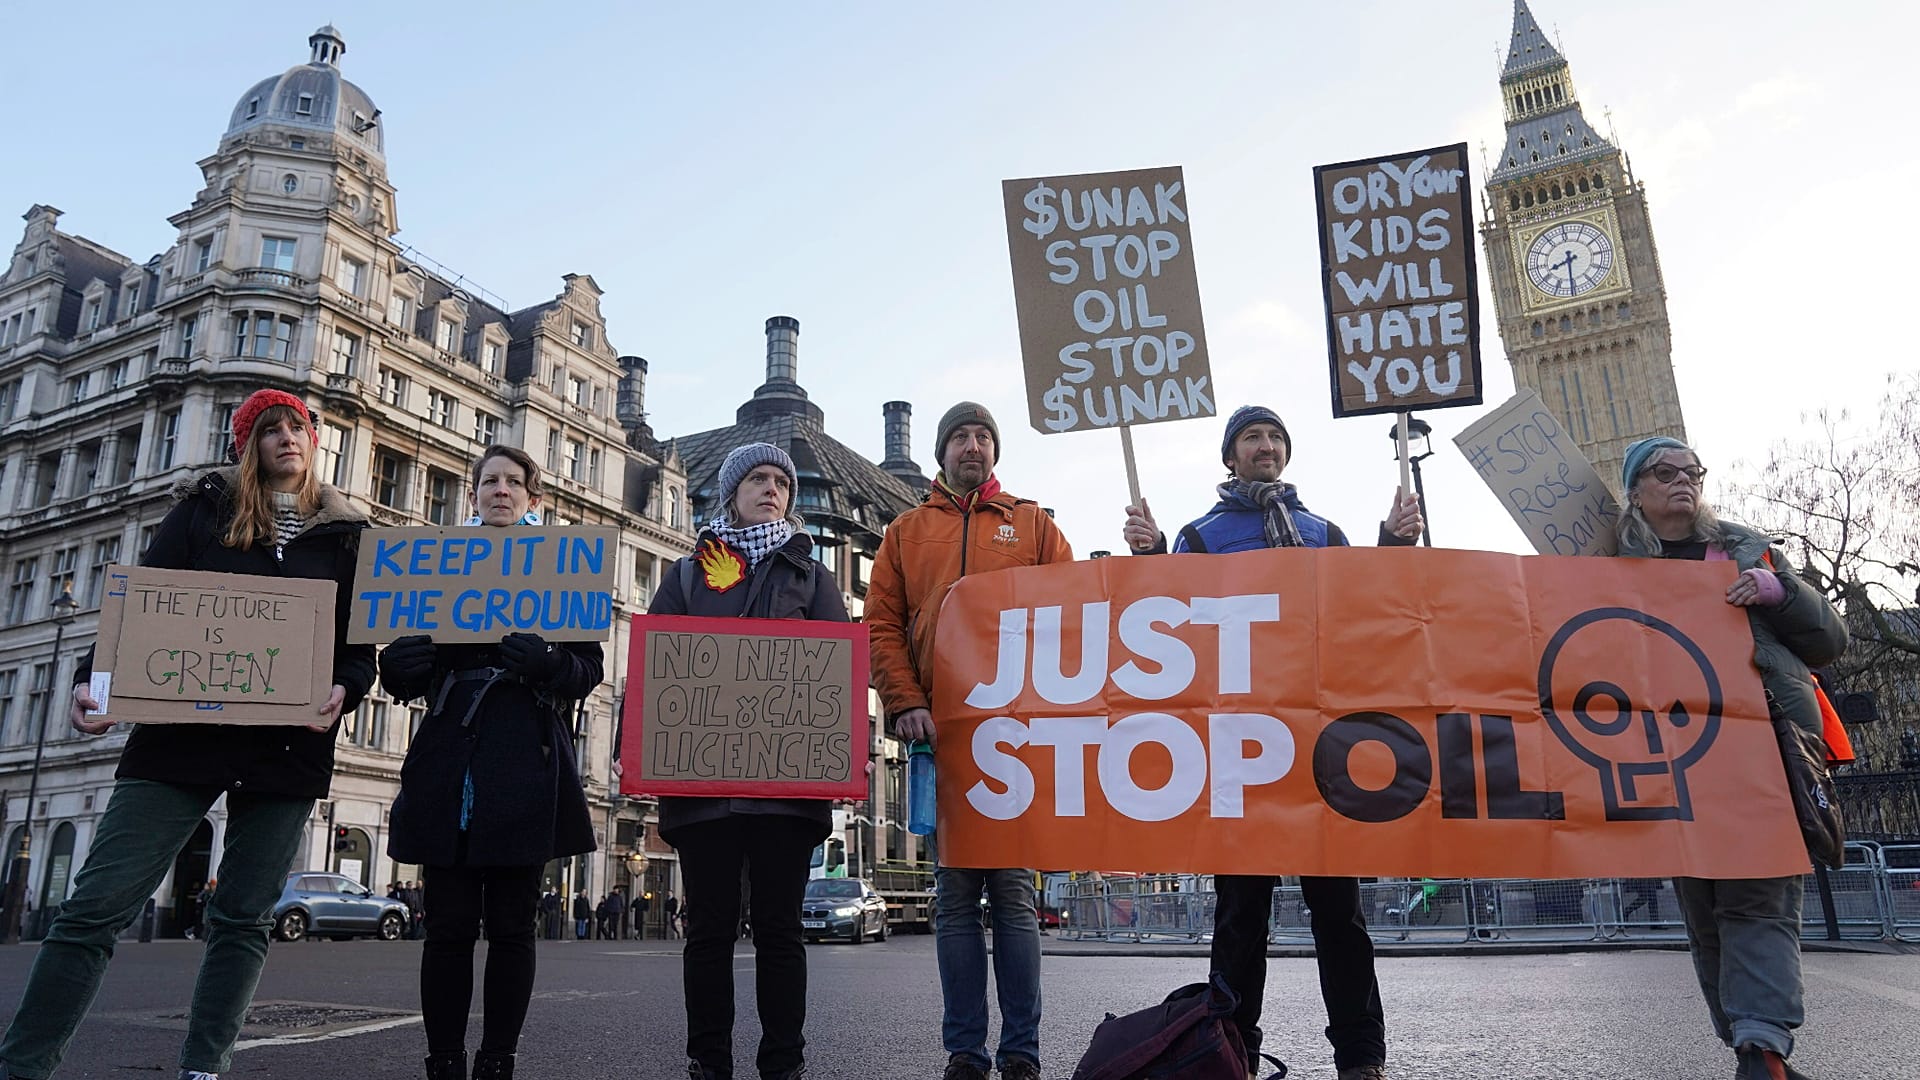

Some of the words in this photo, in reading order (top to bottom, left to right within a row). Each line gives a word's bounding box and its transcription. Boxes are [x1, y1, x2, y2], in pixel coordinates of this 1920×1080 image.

[1023, 181, 1187, 240] $UNAK
[1332, 208, 1451, 263] KIDS
[1046, 231, 1180, 284] STOP
[1335, 257, 1453, 306] WILL
[1073, 284, 1167, 334] OIL
[1338, 302, 1467, 355] HATE
[1059, 331, 1195, 383] STOP
[1347, 351, 1462, 402] YOU
[1043, 376, 1215, 433] $UNAK
[373, 537, 492, 577] KEEP
[502, 536, 545, 576] IT
[557, 536, 604, 574] IN
[136, 590, 189, 615] THE
[196, 594, 289, 621] FUTURE
[360, 590, 443, 629] THE
[452, 589, 612, 632] GROUND
[205, 627, 224, 644] IS
[653, 633, 719, 680] NO
[735, 638, 837, 682] NEW
[964, 593, 1280, 709] JUST
[146, 648, 280, 695] GREEN
[657, 684, 729, 728] OIL
[762, 682, 842, 729] GAS
[653, 731, 851, 782] LICENCES
[964, 712, 1296, 822] STOP
[1312, 711, 1566, 823] OIL
